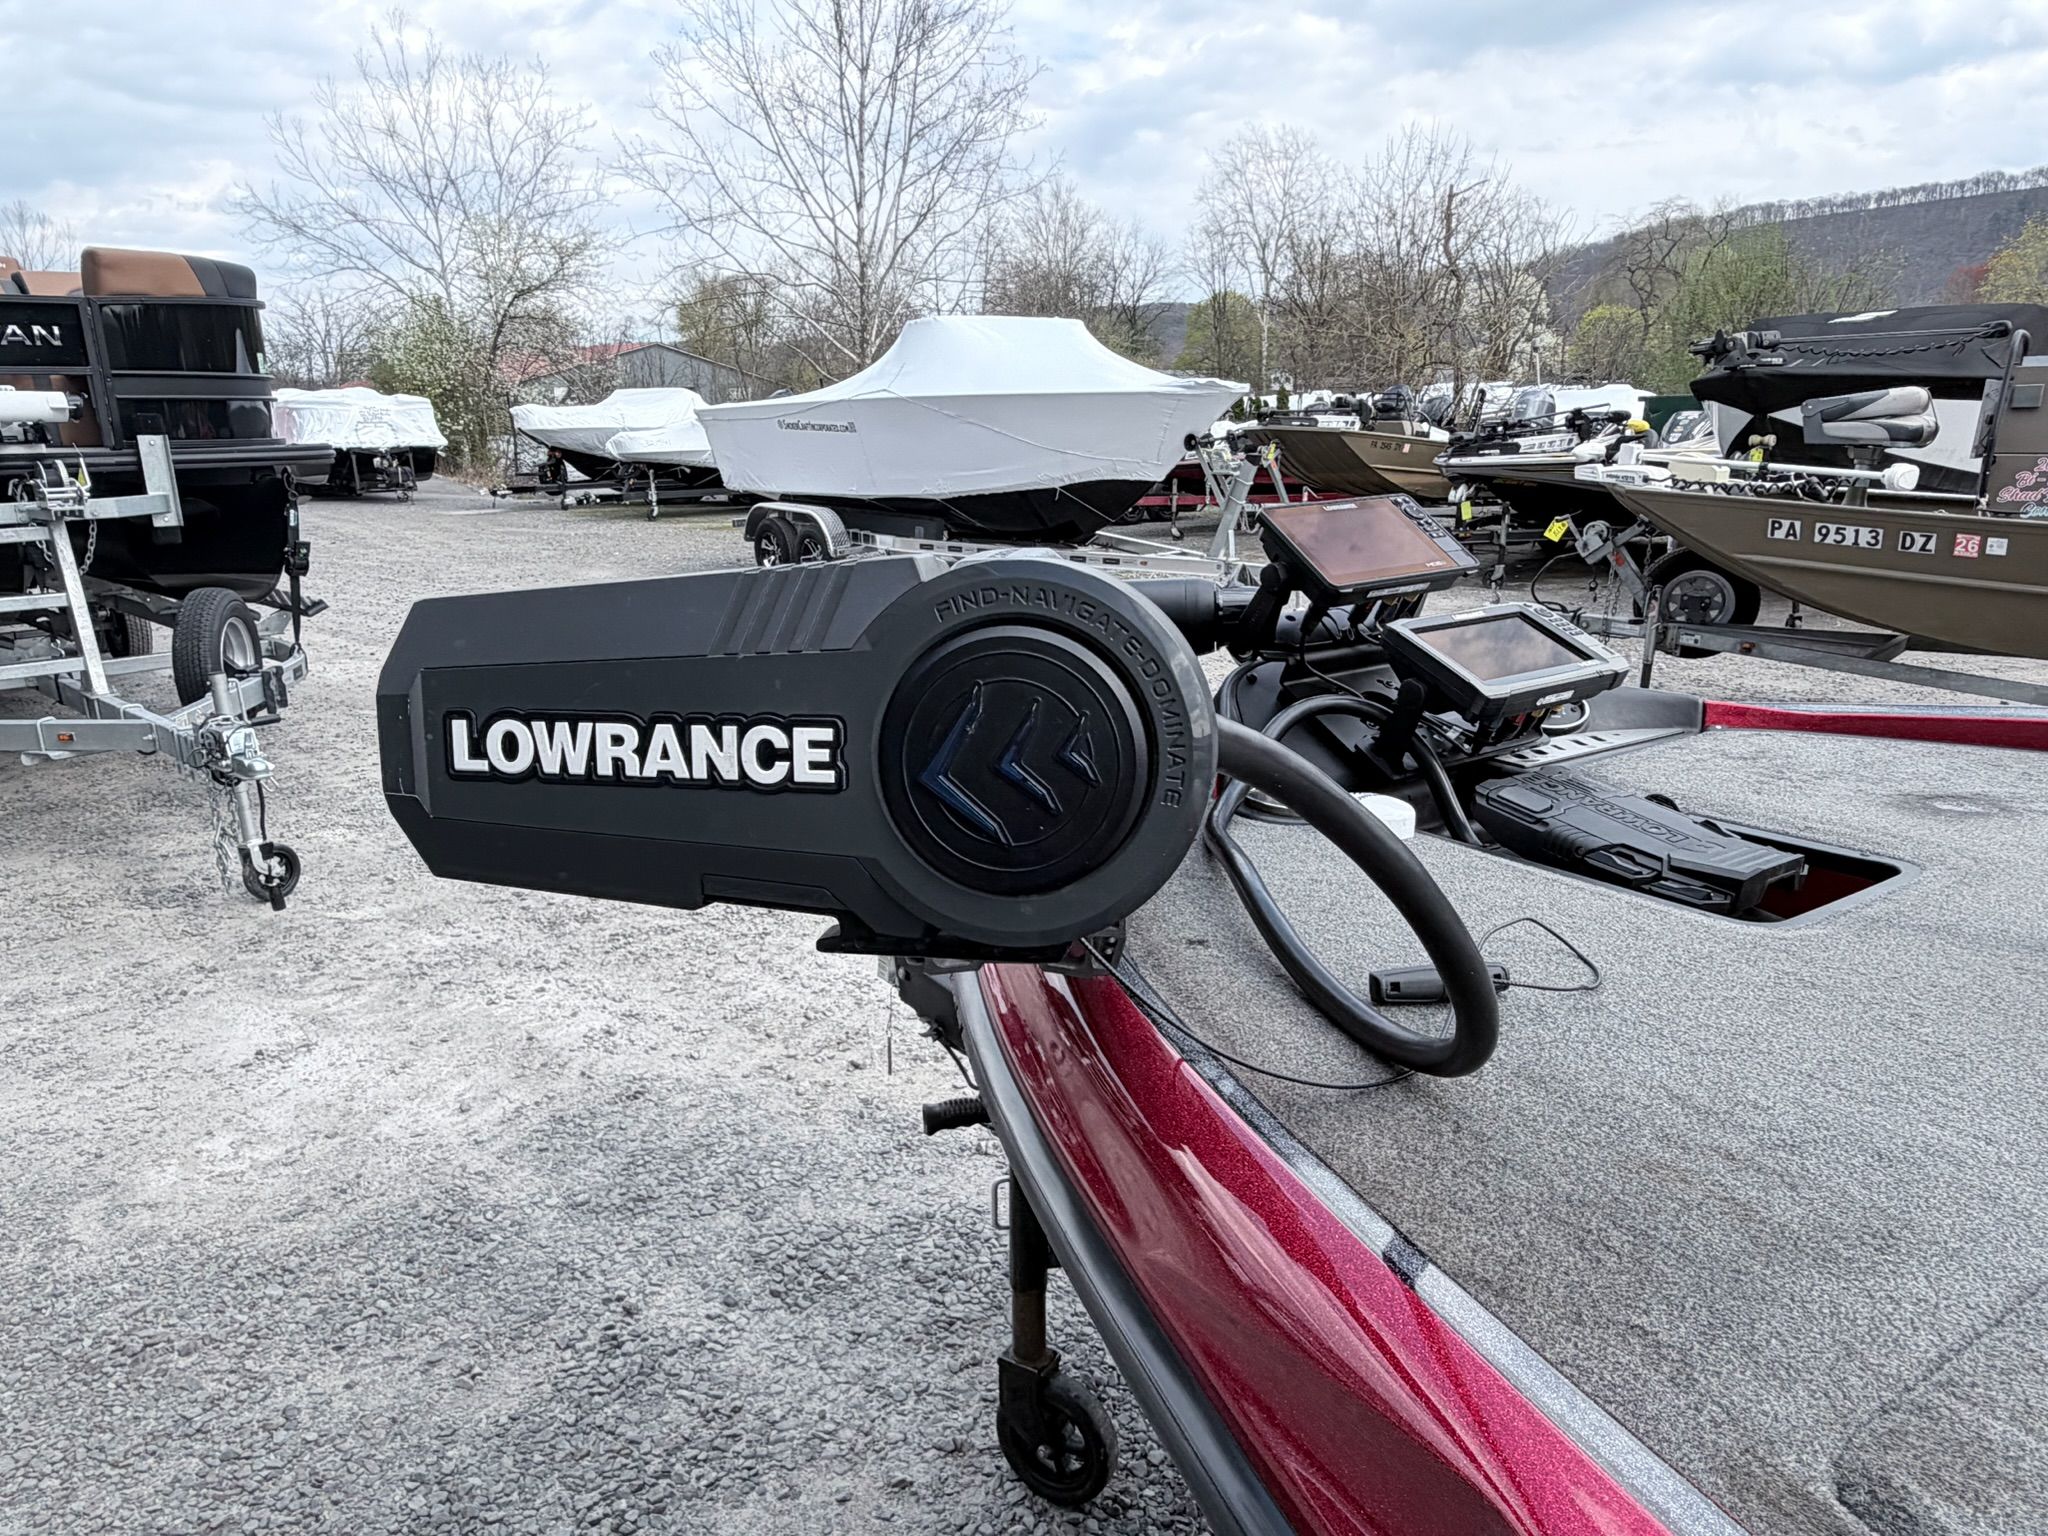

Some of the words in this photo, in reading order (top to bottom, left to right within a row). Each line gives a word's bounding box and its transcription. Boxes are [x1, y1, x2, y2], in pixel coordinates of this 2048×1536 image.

[1770, 520, 1798, 540] PA
[1817, 524, 1880, 548] 9513
[1900, 532, 1934, 553] DZ
[1955, 538, 1980, 553] 26
[451, 718, 836, 784] LOWRANCE
